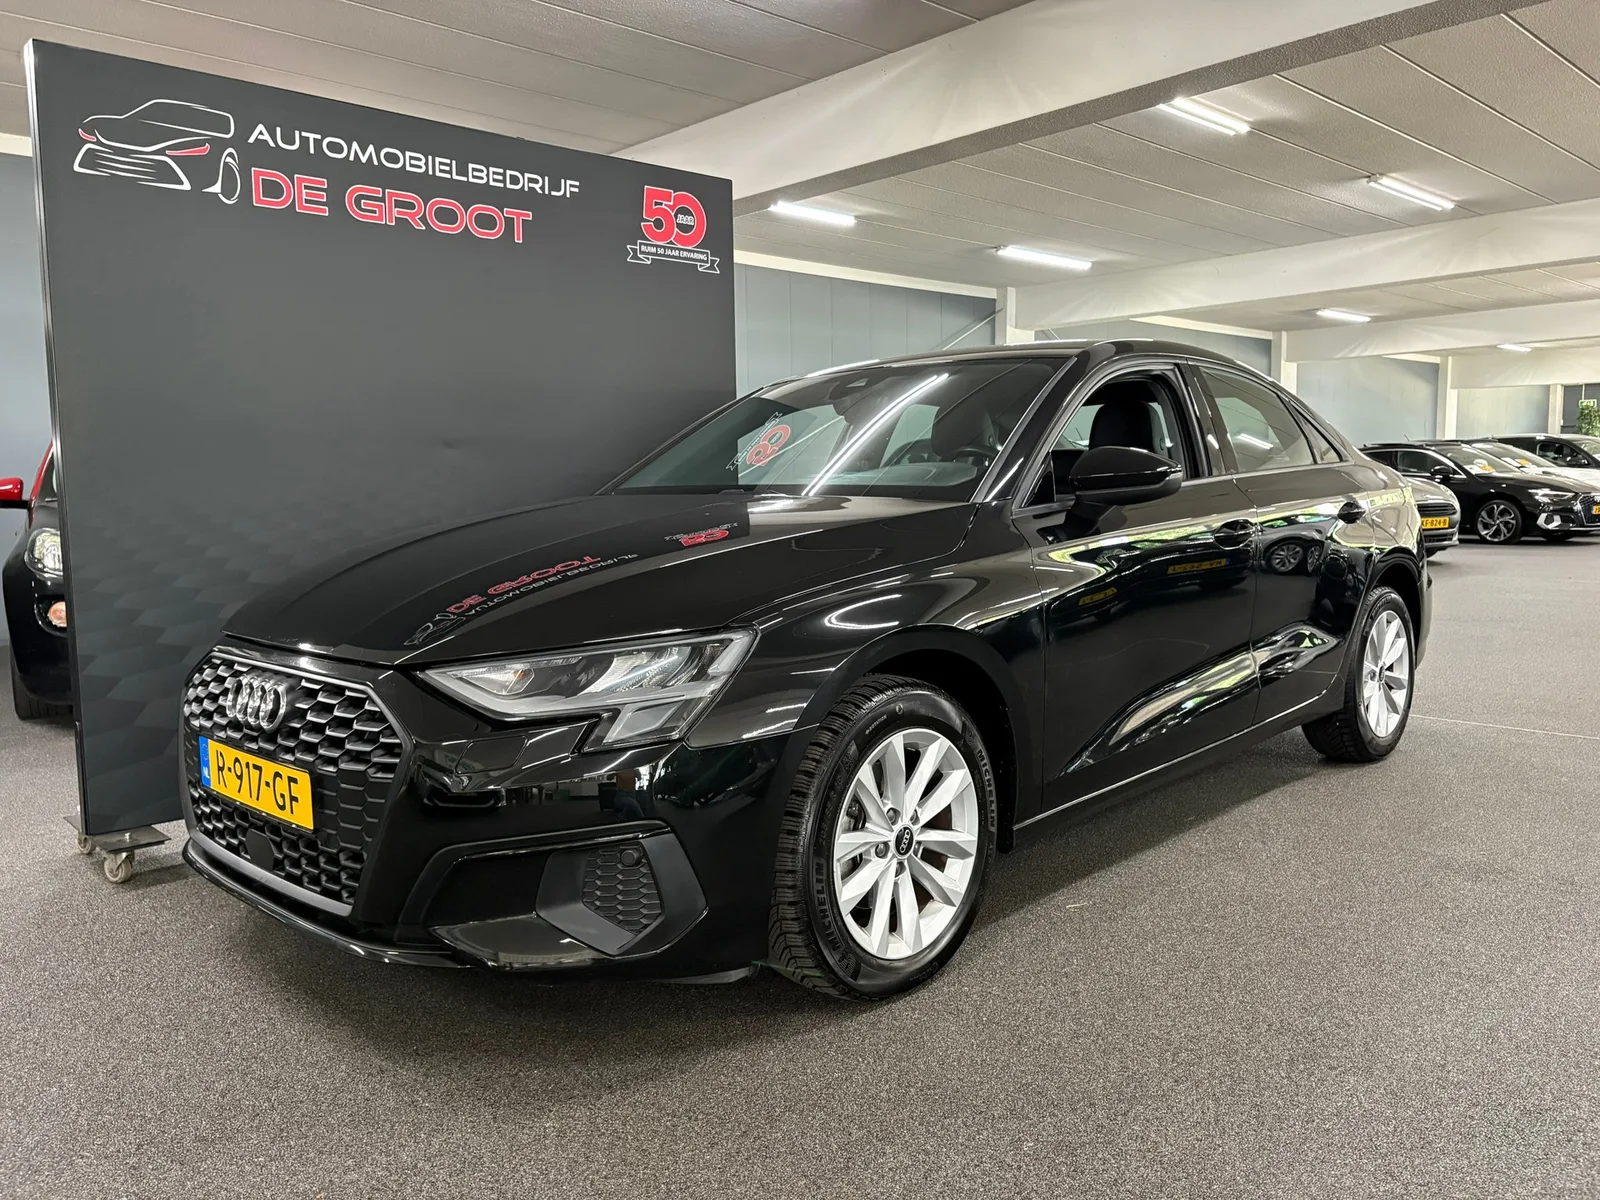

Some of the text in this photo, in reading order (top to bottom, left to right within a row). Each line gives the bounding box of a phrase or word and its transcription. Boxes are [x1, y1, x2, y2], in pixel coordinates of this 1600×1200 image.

[247, 123, 580, 198] AUTOMOBIELBEDRIJF
[251, 167, 532, 243] DE GROOT
[641, 185, 707, 248] 50
[677, 214, 695, 226] JAAR
[640, 245, 656, 253] RUIM
[665, 249, 679, 257] JAAR
[680, 251, 707, 260] ERVARING
[216, 749, 298, 815] R-917-GF
[976, 749, 995, 828] MICHELIN
[815, 861, 840, 951] MICHELIN
